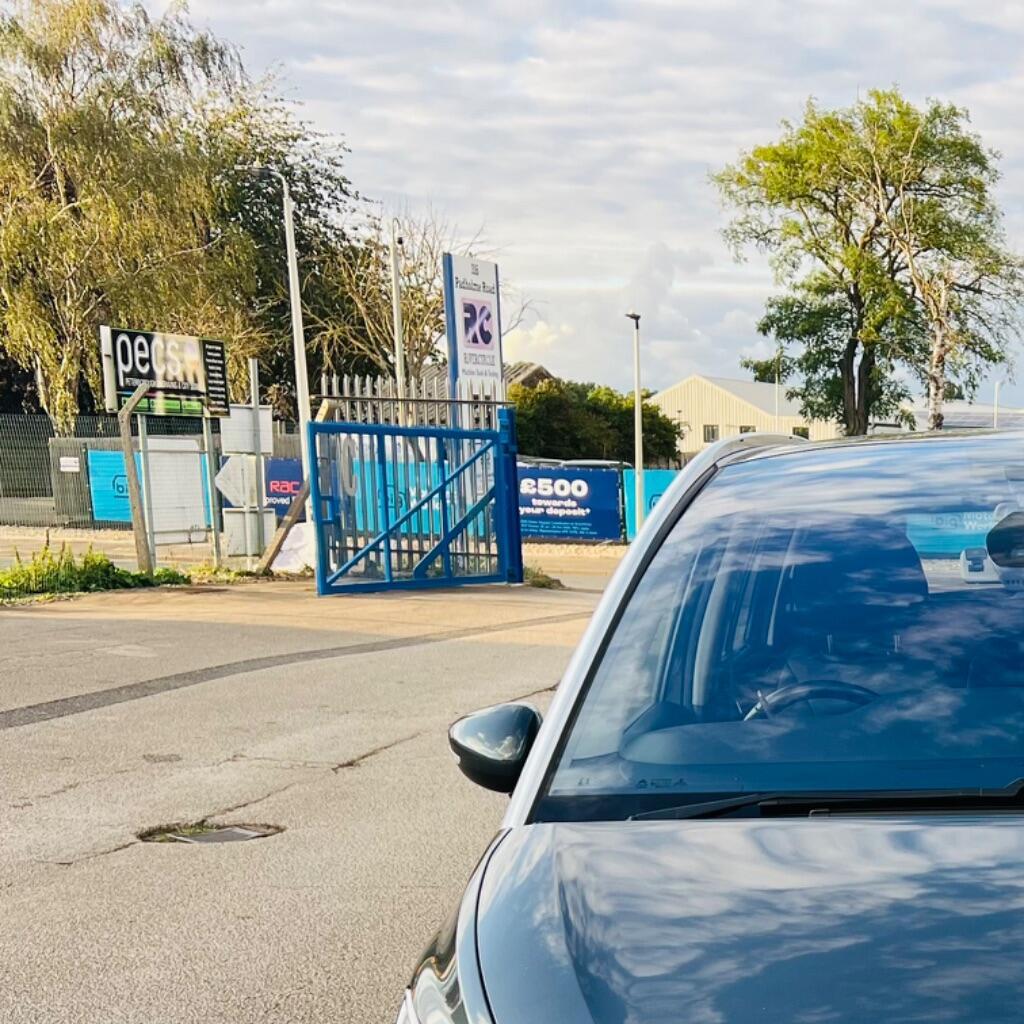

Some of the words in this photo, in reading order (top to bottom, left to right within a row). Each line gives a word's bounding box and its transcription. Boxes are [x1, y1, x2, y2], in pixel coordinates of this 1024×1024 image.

[116, 333, 181, 387] pecs
[116, 482, 129, 495] bi
[519, 477, 589, 498] £500
[531, 498, 577, 508] towards
[519, 506, 544, 515] your
